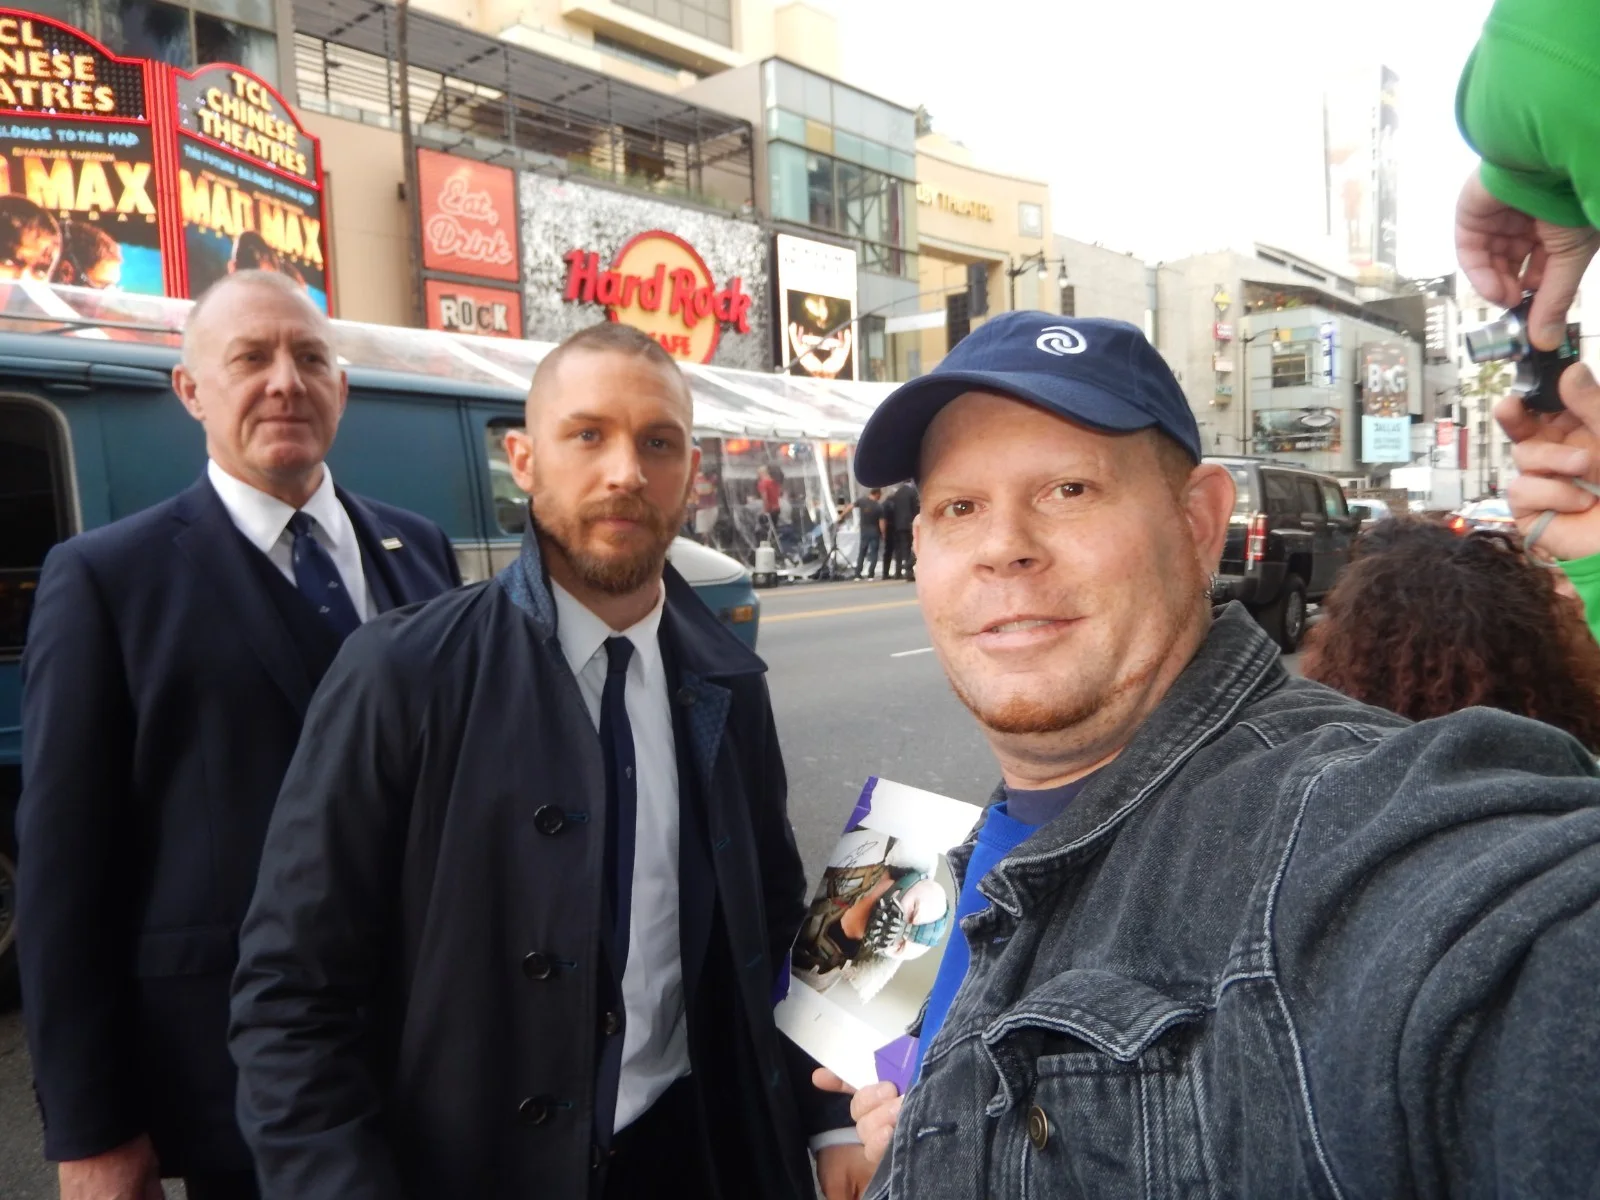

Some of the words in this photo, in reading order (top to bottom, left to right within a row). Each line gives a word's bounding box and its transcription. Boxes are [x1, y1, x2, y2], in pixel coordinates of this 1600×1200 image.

[207, 87, 298, 149] CHINESE
[231, 71, 272, 112] TCL
[198, 107, 307, 176] THEATRES
[24, 155, 157, 214] MAX
[179, 168, 255, 237] MAD
[259, 199, 323, 264] MAX
[440, 294, 509, 331] ROCK
[562, 248, 666, 312] Hard
[669, 266, 752, 334] Rock
[647, 332, 691, 356] AFE
